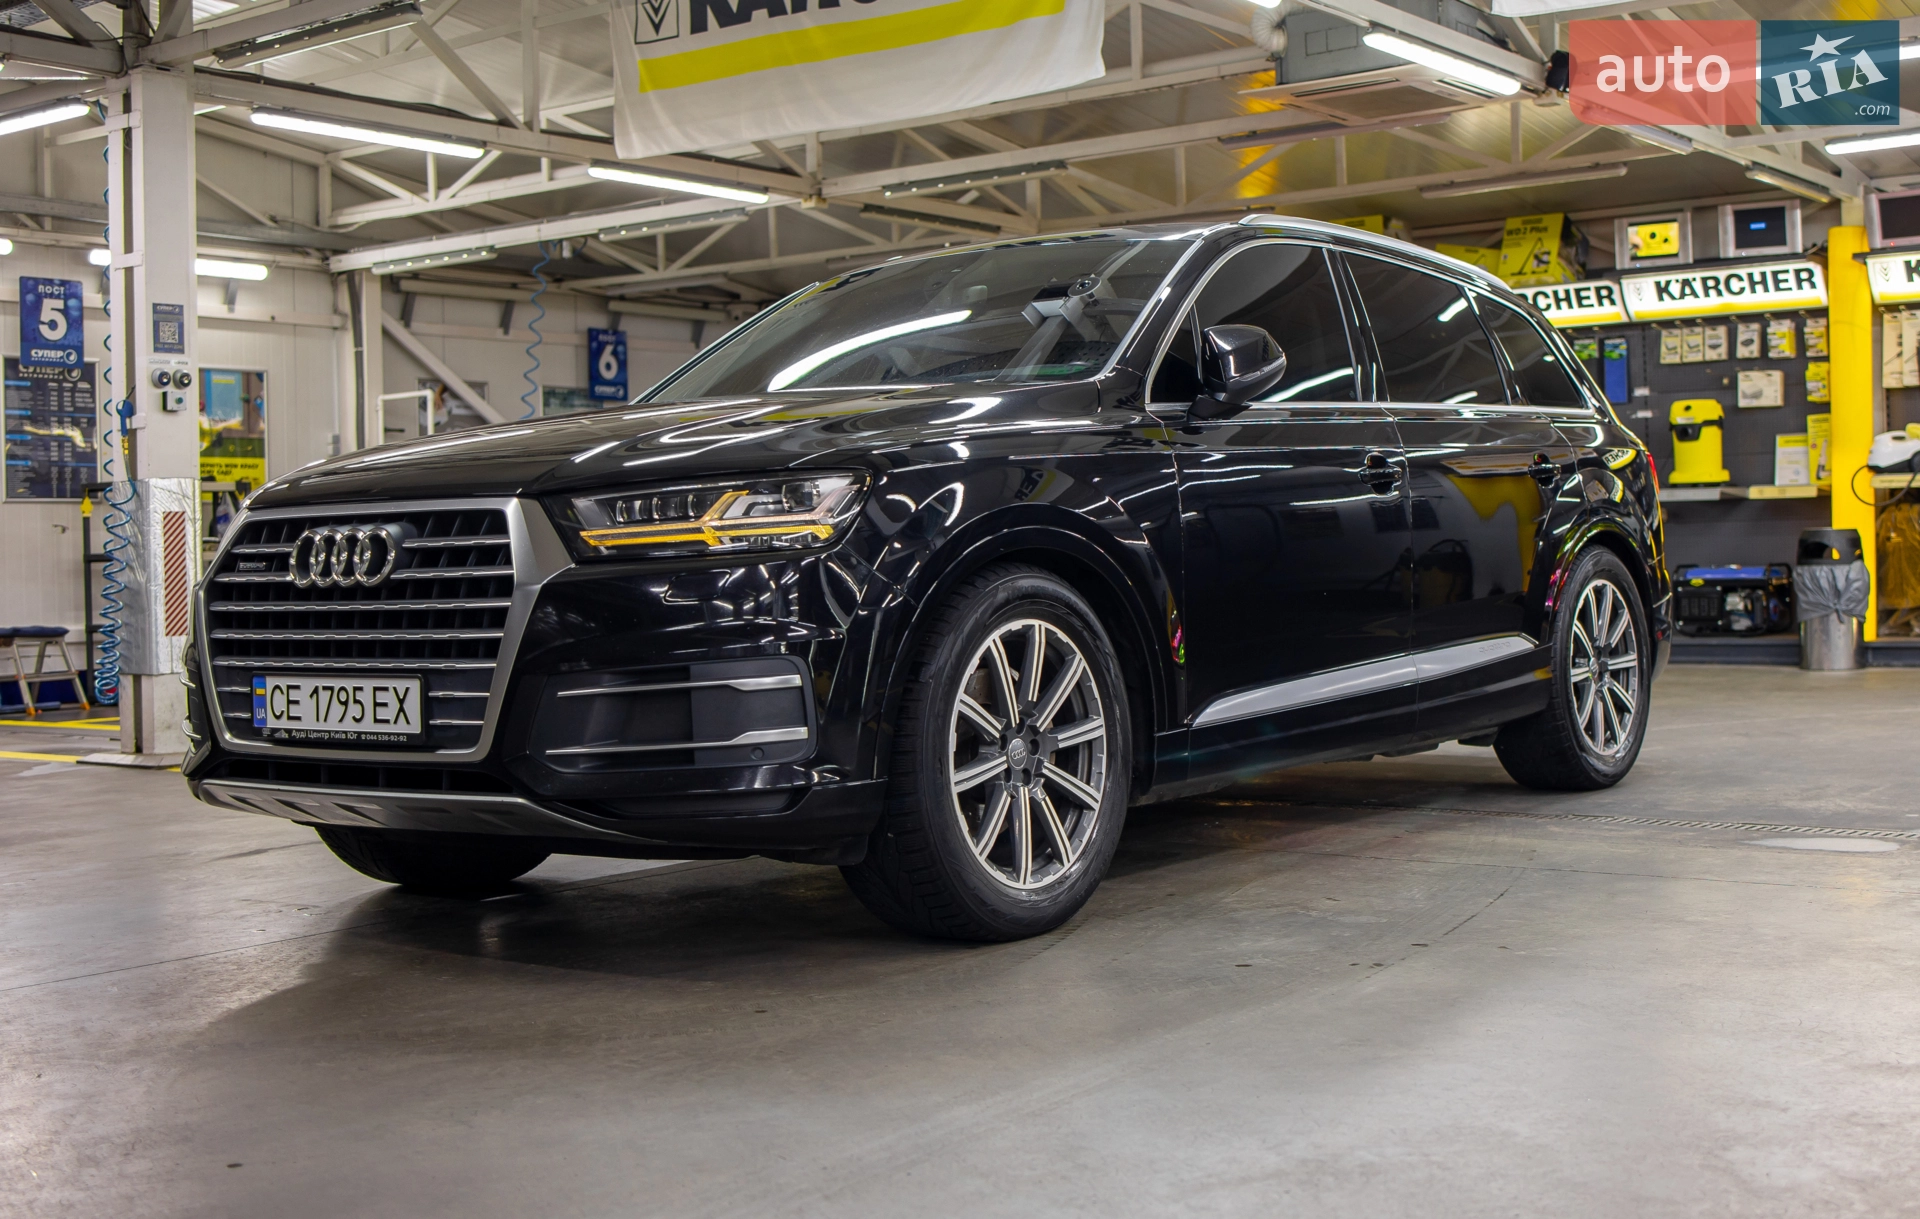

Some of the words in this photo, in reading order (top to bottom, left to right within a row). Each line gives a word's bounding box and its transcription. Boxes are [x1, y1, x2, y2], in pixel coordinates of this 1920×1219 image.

[1654, 267, 1817, 302] KÄRCHER
[38, 298, 68, 341] 5
[31, 348, 64, 357] СУПЕР
[598, 343, 618, 380] 6
[256, 708, 266, 719] UA
[270, 684, 302, 721] CE
[309, 685, 365, 723] 1795
[373, 686, 411, 725] EX
[291, 729, 306, 738] Ауді
[308, 730, 329, 740] Центр
[331, 731, 346, 739] Київ
[347, 732, 358, 740] Юг
